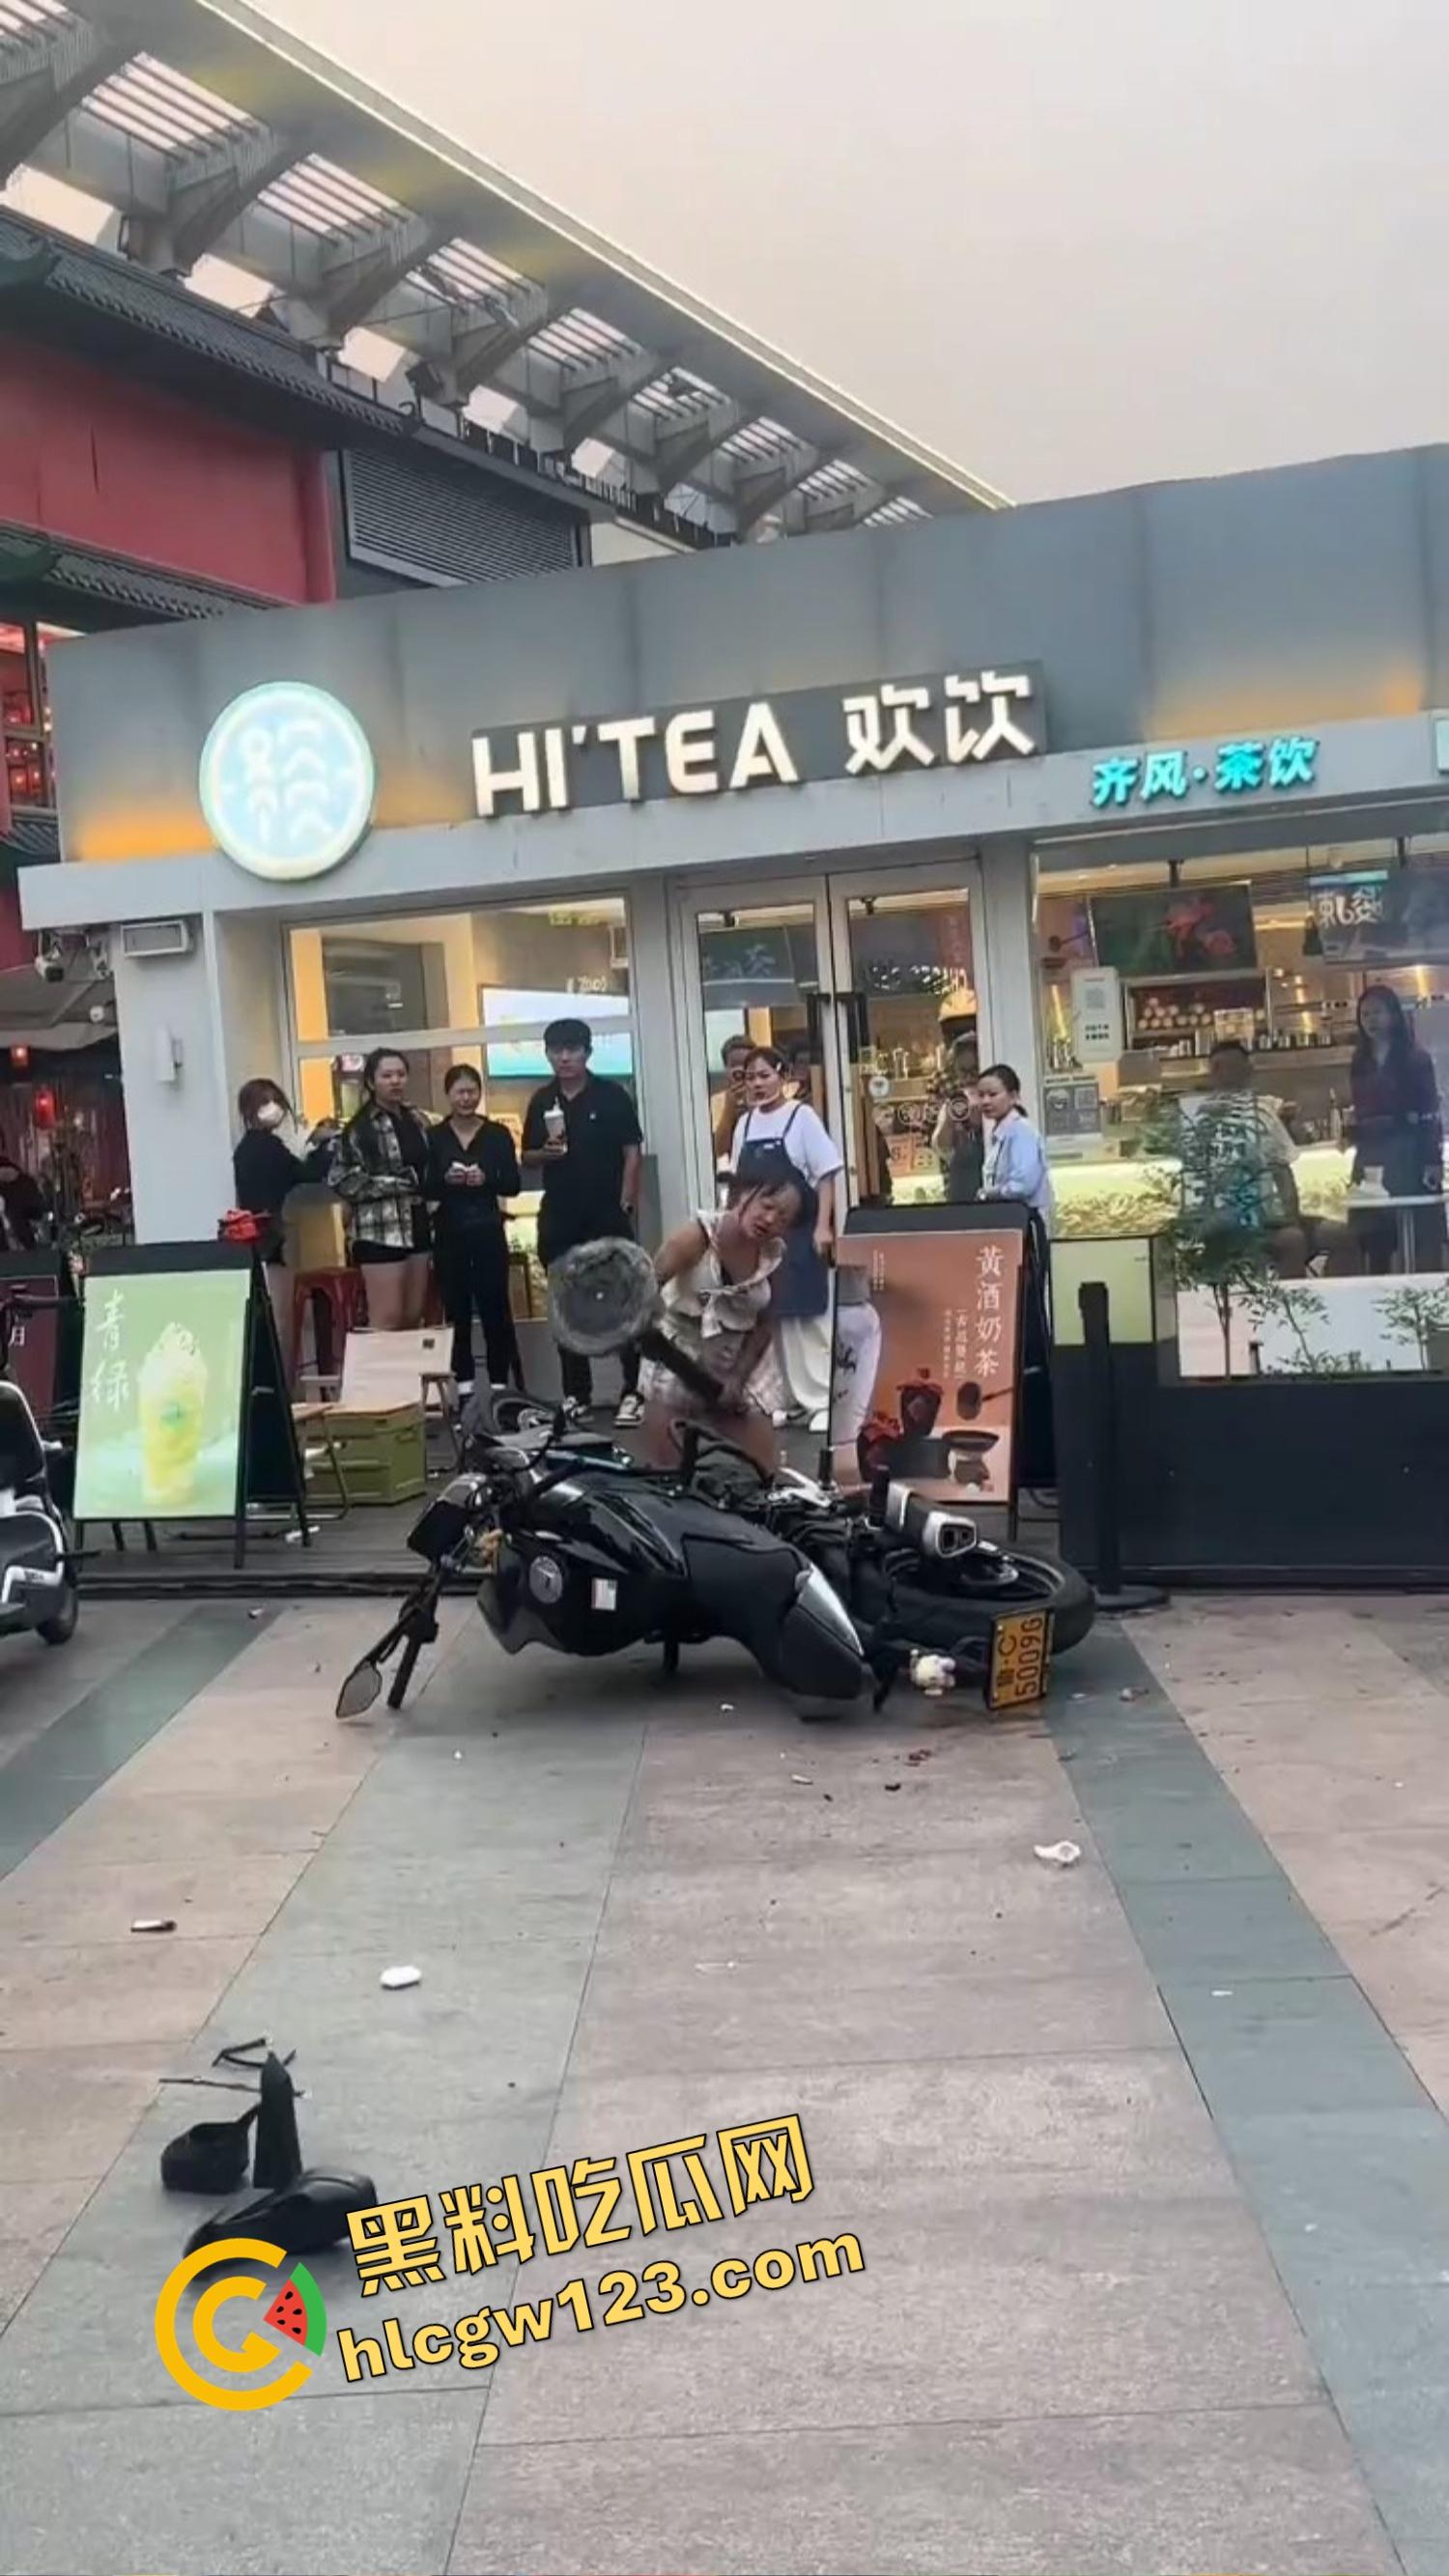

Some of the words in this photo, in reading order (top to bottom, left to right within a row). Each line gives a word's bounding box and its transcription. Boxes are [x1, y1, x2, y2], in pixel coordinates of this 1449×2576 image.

[471, 701, 800, 817] HI'TEA
[841, 670, 1036, 774] 欢饮
[1092, 737, 1321, 807] 齐风·茶饮
[975, 1244, 1004, 1378] 黄酒奶茶
